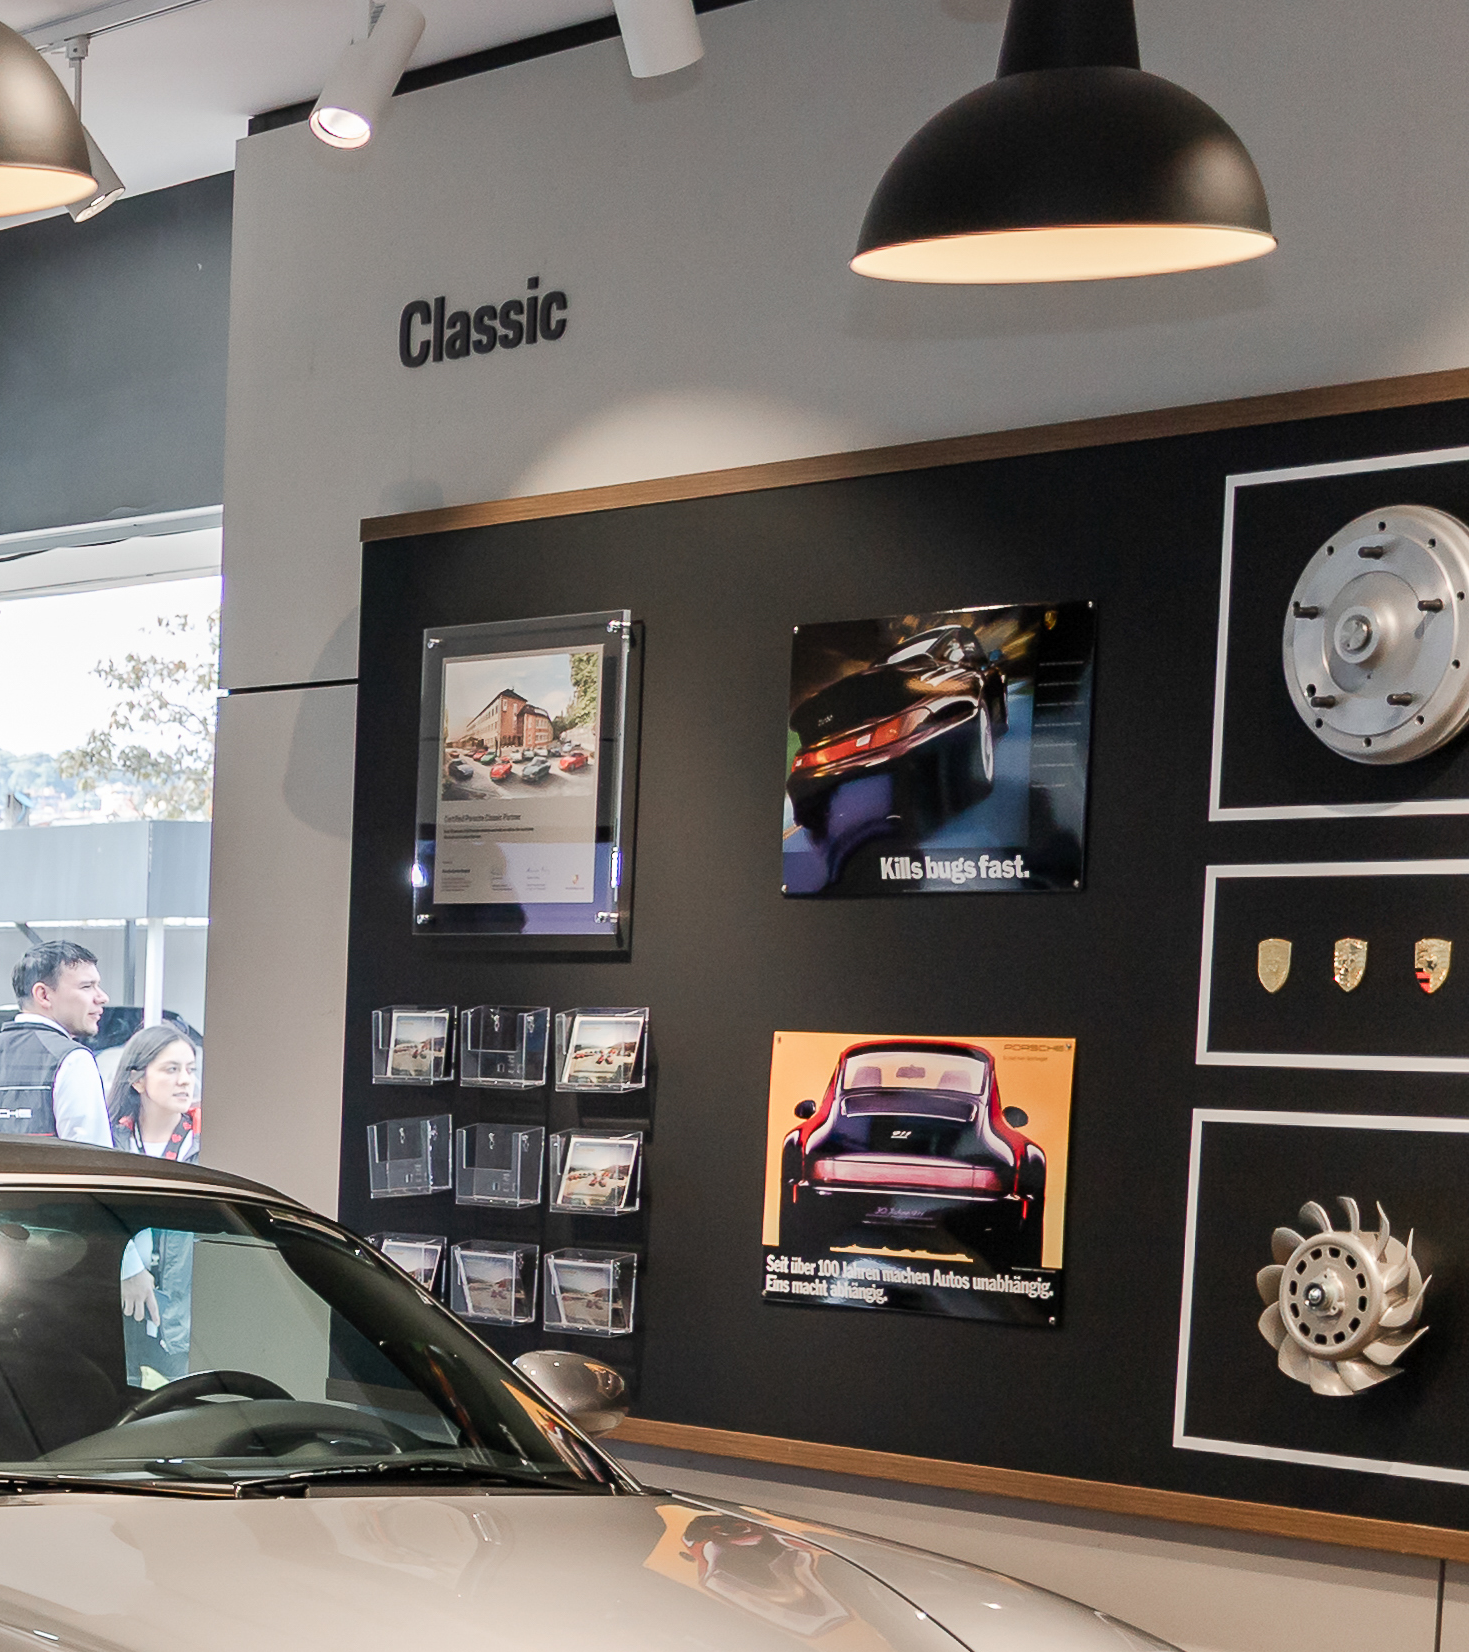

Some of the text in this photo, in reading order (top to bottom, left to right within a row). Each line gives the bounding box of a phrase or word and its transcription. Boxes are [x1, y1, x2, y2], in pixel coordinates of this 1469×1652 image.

[398, 275, 569, 369] Classic
[880, 854, 1030, 884] Kills bugs fast.
[765, 1253, 1054, 1299] Seit über 100 Jahren machen Autos unabhängig.
[765, 1273, 888, 1304] Eins macht abhängig.
